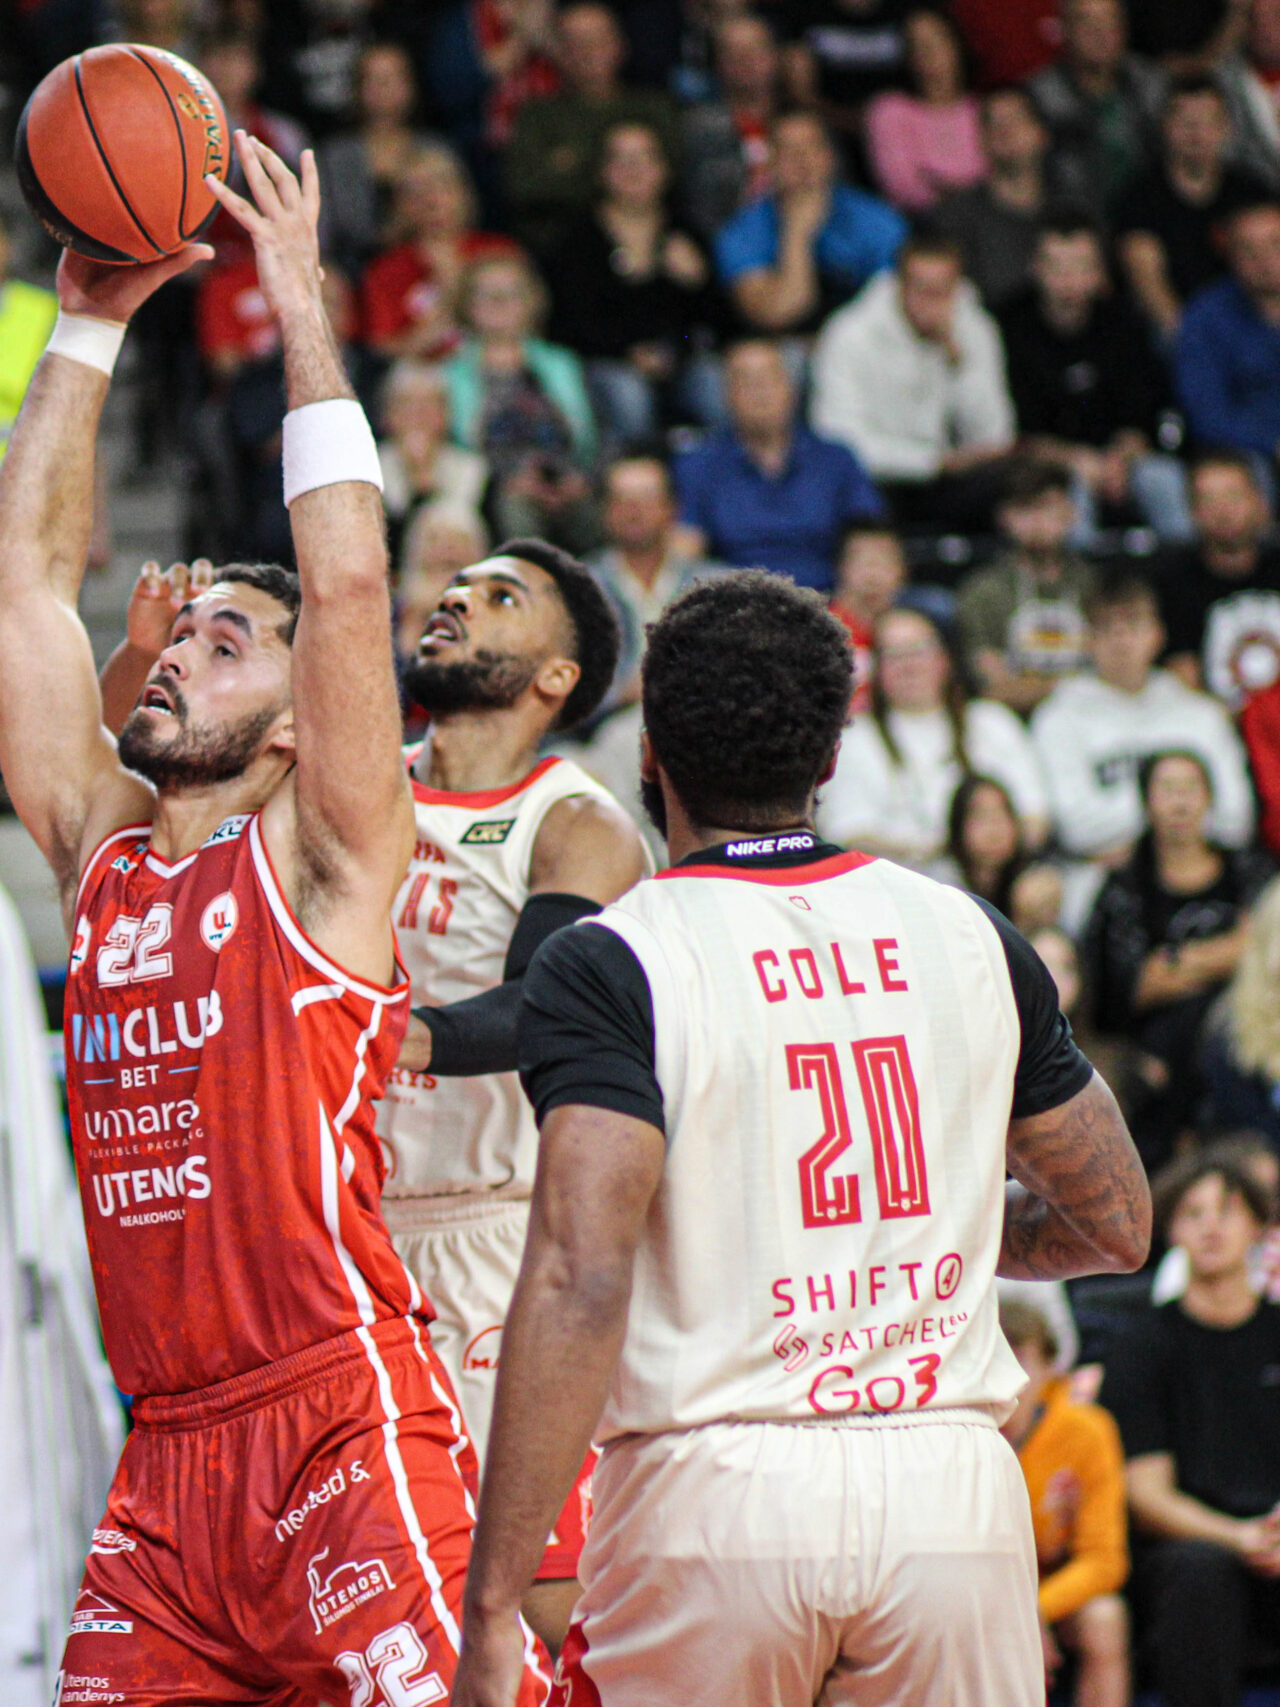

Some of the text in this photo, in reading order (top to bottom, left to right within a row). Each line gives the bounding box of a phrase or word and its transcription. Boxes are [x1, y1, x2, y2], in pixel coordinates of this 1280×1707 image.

[726, 835, 814, 857] NIKE PRO
[97, 902, 174, 989] 22
[752, 937, 909, 1004] COLE
[121, 1064, 160, 1089] BET
[784, 1034, 932, 1229] 20
[93, 1155, 213, 1217] UTENOS
[350, 1460, 371, 1483] &
[316, 1570, 382, 1617] UTENOS
[64, 1689, 126, 1705] andenys
